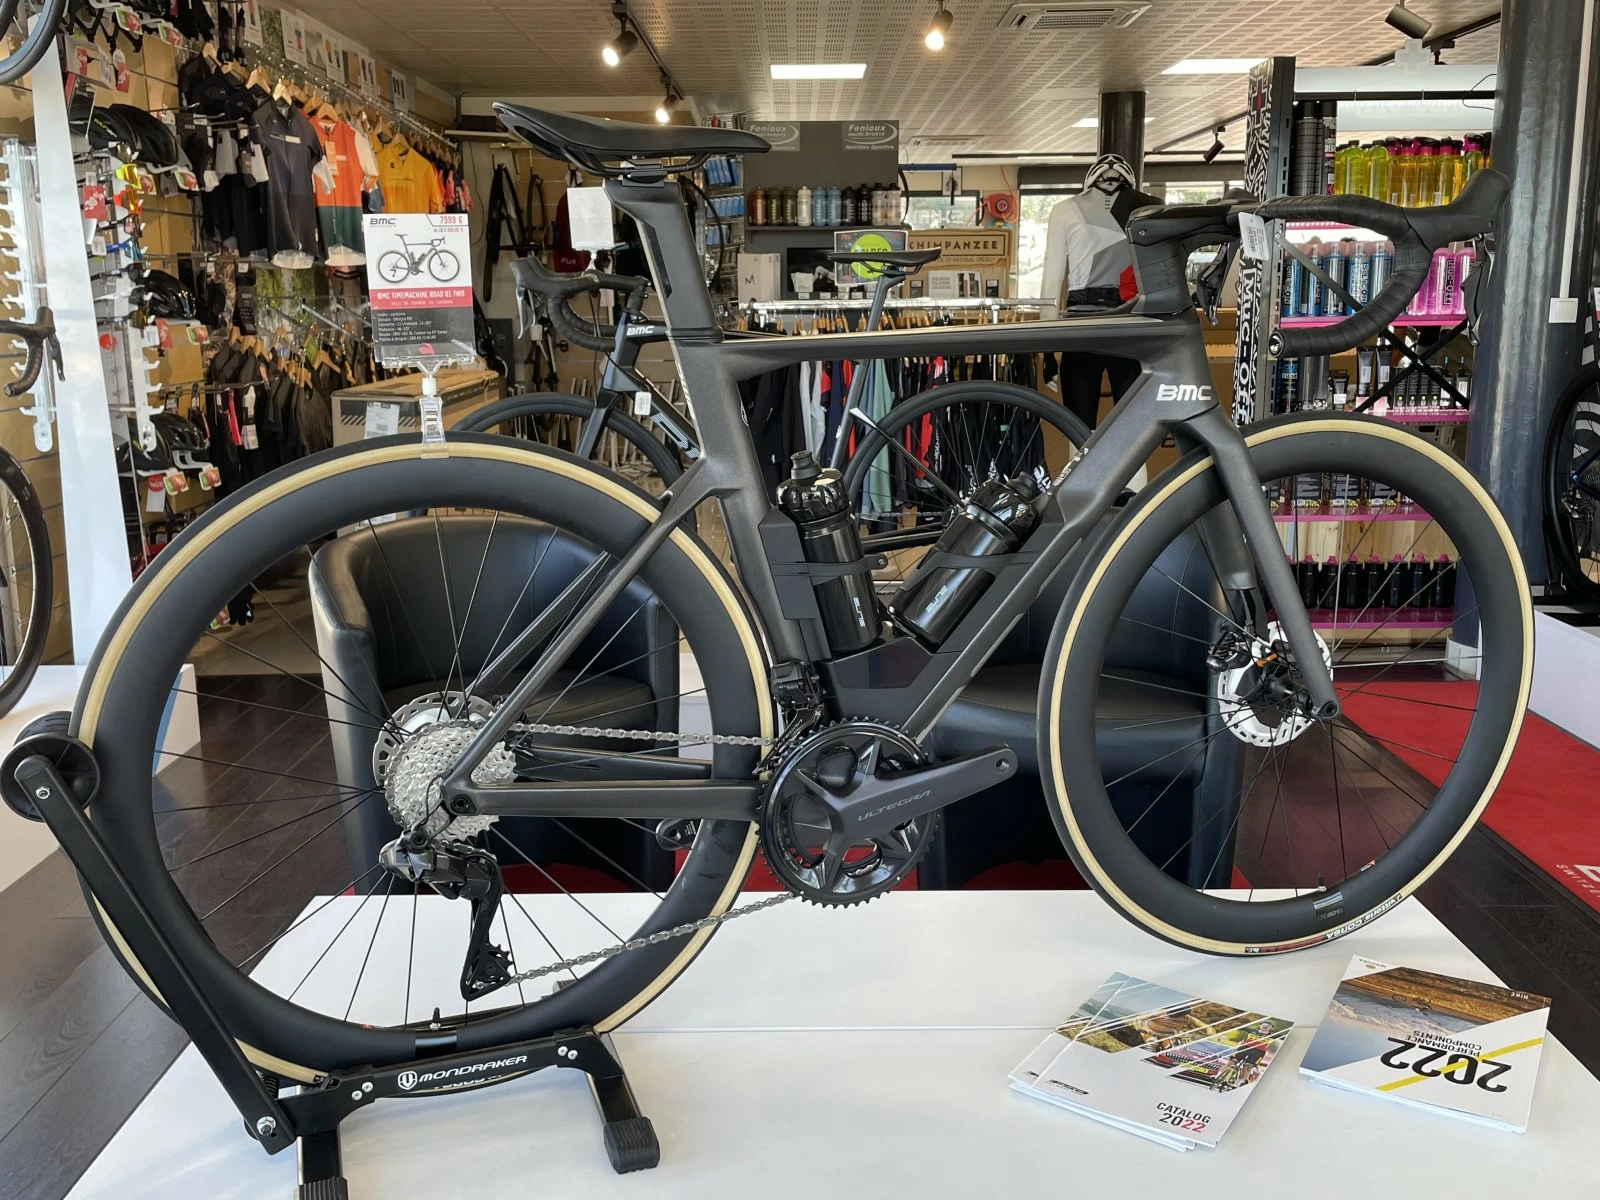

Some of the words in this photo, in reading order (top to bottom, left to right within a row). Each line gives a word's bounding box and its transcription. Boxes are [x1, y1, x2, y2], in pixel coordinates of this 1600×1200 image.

[848, 124, 886, 132] Fenioux
[440, 216, 456, 224] 7999
[909, 240, 998, 250] CHIMPANZEE
[391, 291, 428, 299] TIMEMACHINE
[626, 326, 654, 336] BMC
[1157, 384, 1212, 401] BMC
[857, 789, 931, 822] ULTEGRA
[1326, 919, 1363, 940] CORSA
[1510, 991, 1529, 1000] BIKE
[1405, 1034, 1481, 1058] PERFORMANCE
[1413, 1030, 1482, 1051] COMPONENTS
[418, 1055, 528, 1082] MONDRAKER
[1380, 1036, 1512, 1093] 2022
[1157, 1102, 1211, 1124] CATALOG
[1158, 1113, 1206, 1133] 2022
